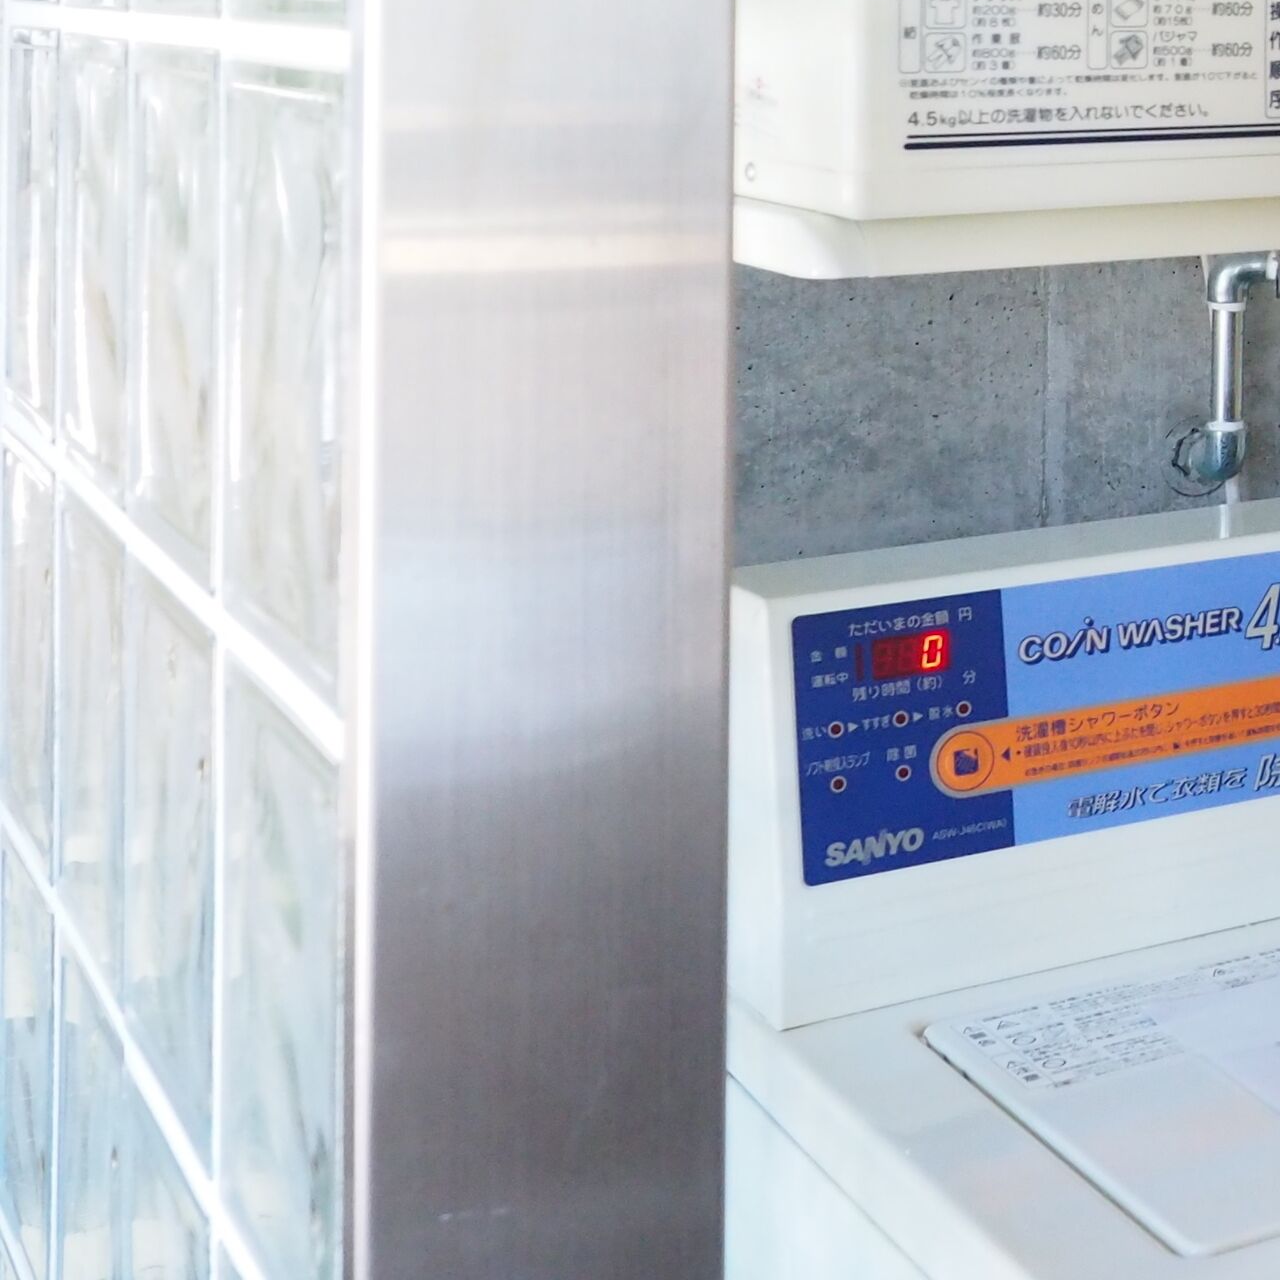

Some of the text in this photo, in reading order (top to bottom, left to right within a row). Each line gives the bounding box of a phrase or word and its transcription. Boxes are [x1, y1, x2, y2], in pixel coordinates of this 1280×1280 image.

[1037, 2, 1082, 18] 約30分
[907, 103, 1209, 128] 4.5kg以上の洗濯物を入れないでください。
[847, 606, 973, 638] ただいまの金額 円
[1018, 617, 1111, 665] COIN
[1118, 606, 1242, 649] WASHER
[921, 634, 943, 669] 0
[811, 672, 849, 689] 運転中
[962, 670, 977, 685] 分
[1016, 701, 1181, 743] 洗濯槽シャワーボタン
[1067, 767, 1248, 819] 電解水で衣類を
[825, 825, 925, 869] SANYO
